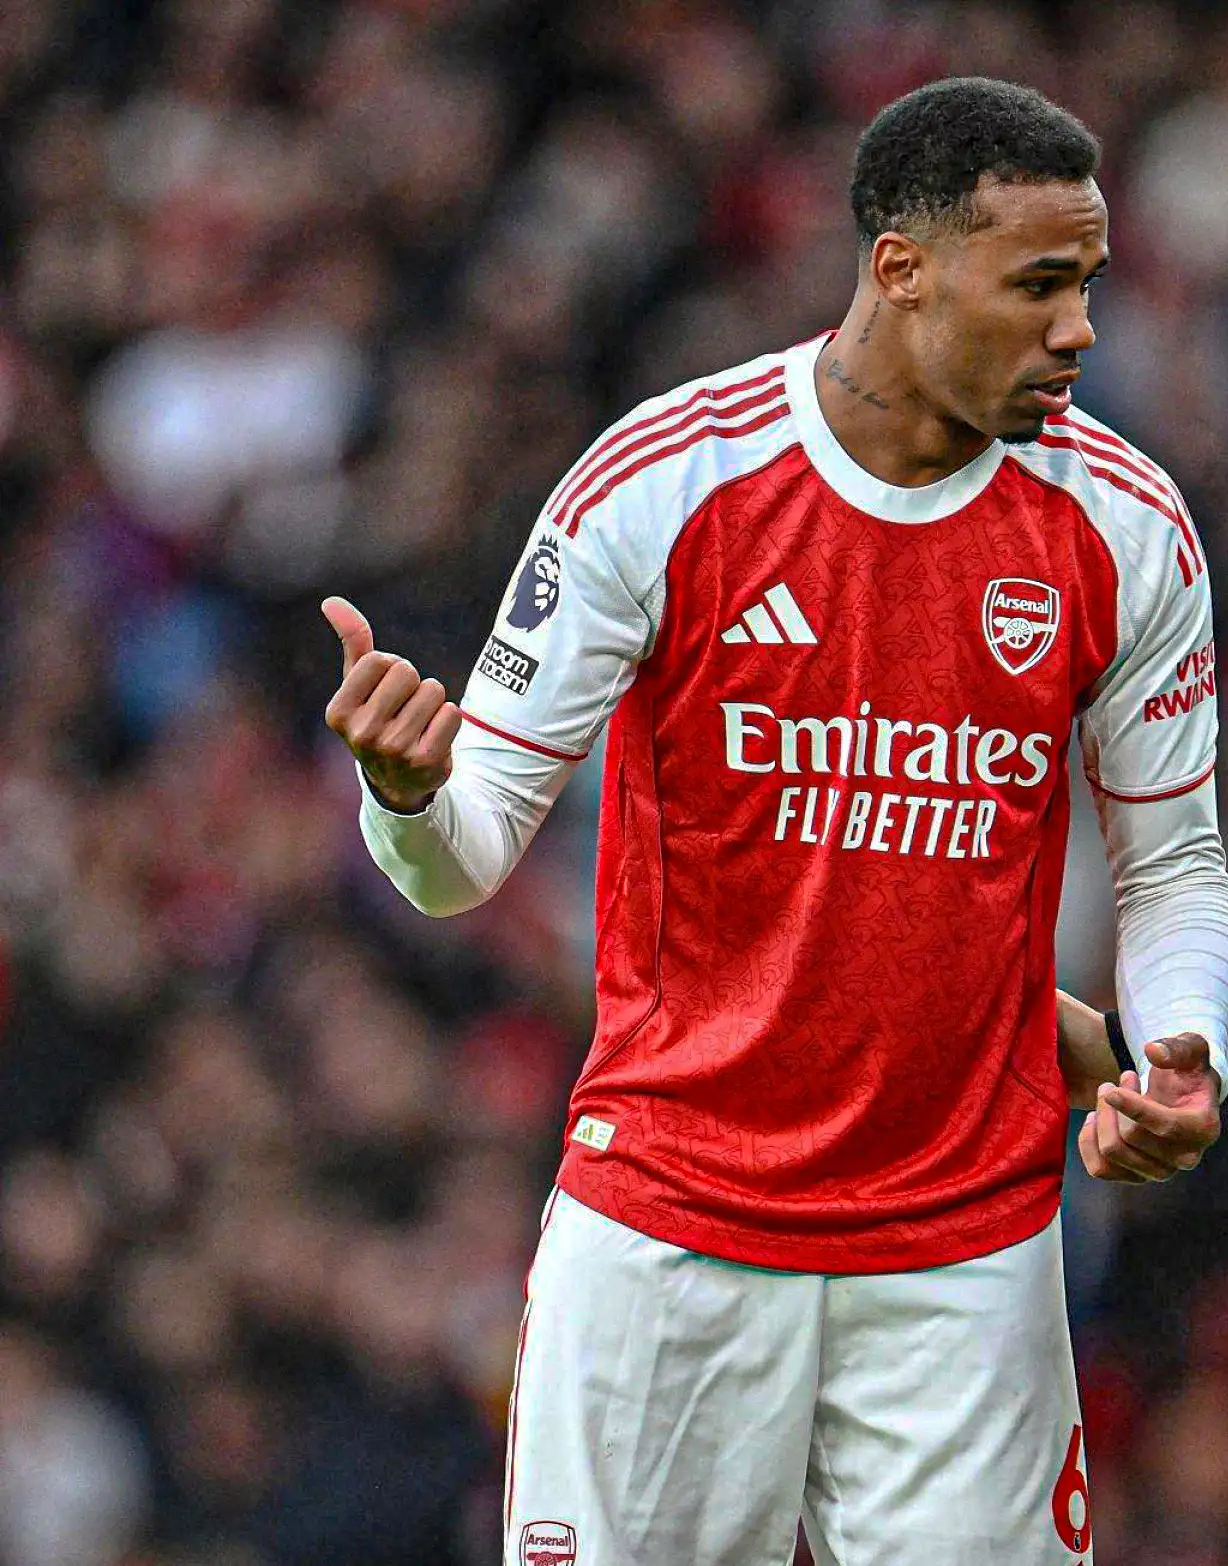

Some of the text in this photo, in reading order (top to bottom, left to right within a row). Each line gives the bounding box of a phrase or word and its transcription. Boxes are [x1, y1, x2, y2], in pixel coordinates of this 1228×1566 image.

[995, 593, 1049, 614] Arsenal
[481, 657, 528, 694] racism
[488, 642, 529, 676] room
[1144, 670, 1214, 722] RWAN
[719, 700, 1052, 787] Emirates
[774, 786, 998, 860] FLY BETTER
[1052, 1424, 1091, 1554] 6
[526, 1534, 569, 1547] Arsenal
